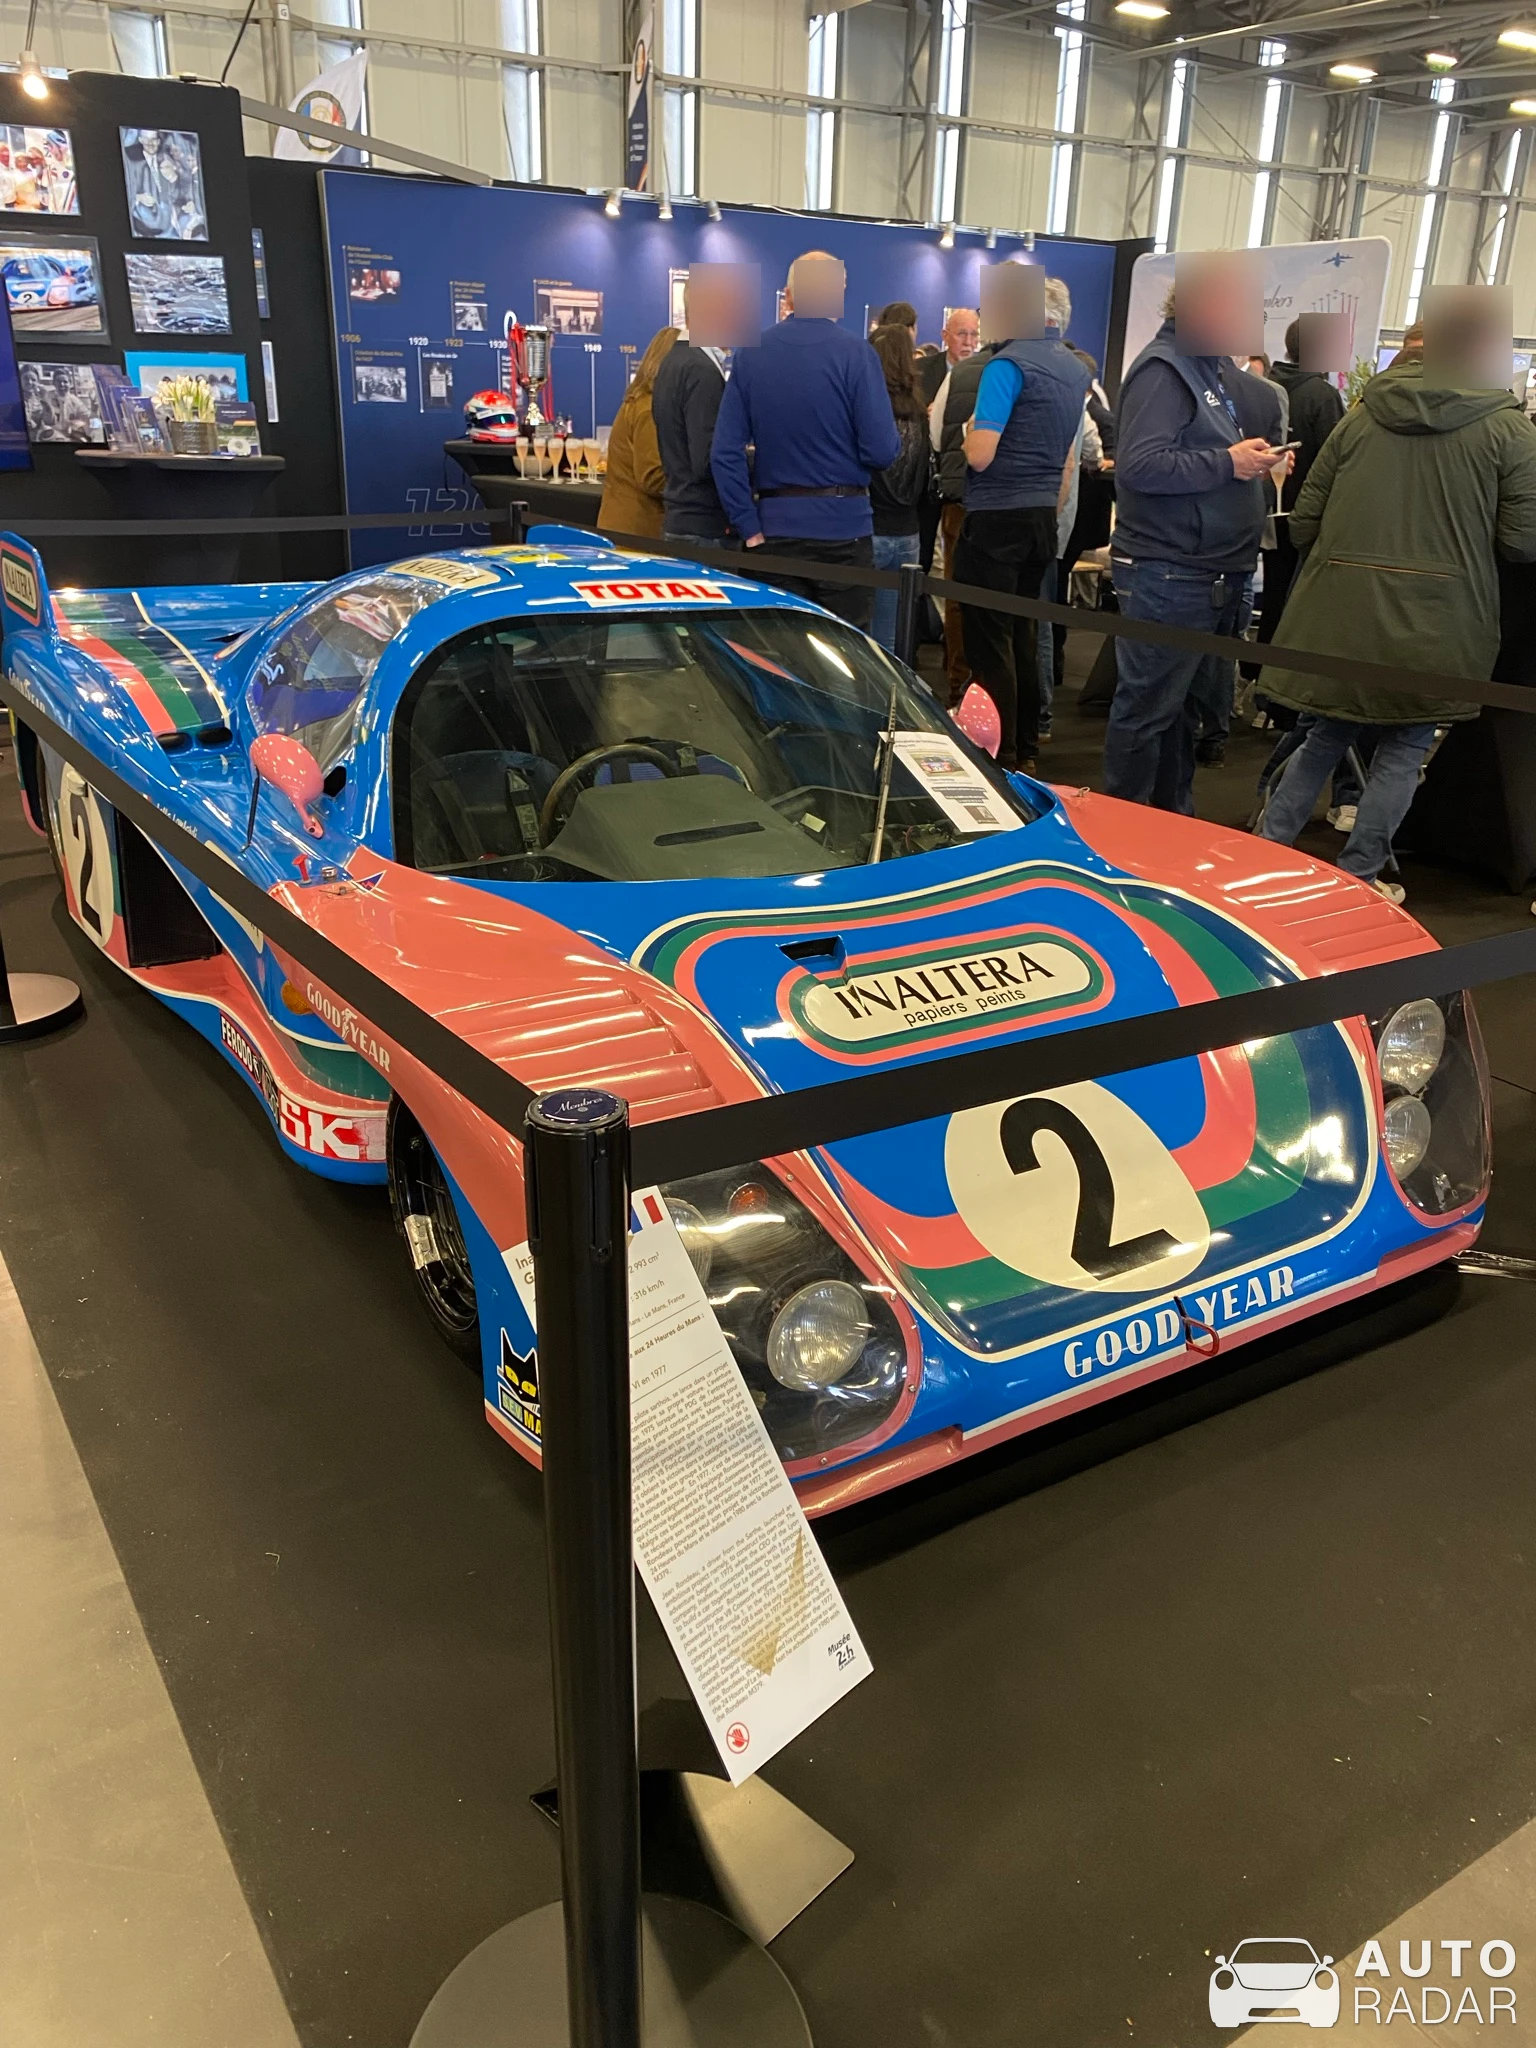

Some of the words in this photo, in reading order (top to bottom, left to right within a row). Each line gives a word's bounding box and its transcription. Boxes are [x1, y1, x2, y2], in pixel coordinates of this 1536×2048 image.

[340, 334, 361, 343] 1906
[408, 337, 429, 346] 1920
[444, 339, 464, 347] 1923
[488, 340, 507, 349] 1930
[583, 344, 602, 352] 1949
[619, 345, 636, 353] 1954
[4, 563, 34, 603] INALTERA
[579, 582, 724, 600] TOTAL
[70, 793, 102, 937] 2
[834, 951, 1055, 1019] INALTERA
[903, 1000, 968, 1027] papiers
[976, 988, 1027, 1011] peints
[221, 1016, 253, 1072] FERODO
[555, 1098, 603, 1115] Membres
[1000, 1097, 1184, 1281] 2
[634, 1289, 647, 1300] 316
[647, 1280, 664, 1292] km/h
[651, 1304, 668, 1314] Mans,
[668, 1294, 685, 1305] France
[634, 1346, 645, 1356] aux
[645, 1340, 654, 1349] 24
[654, 1329, 676, 1343] Heures
[676, 1324, 685, 1332] du
[685, 1315, 701, 1326] Mans
[632, 1380, 641, 1389] Vi
[641, 1377, 650, 1385] en
[651, 1365, 666, 1378] 1977
[634, 1409, 649, 1422] pilote
[650, 1397, 671, 1411] sarthois,
[679, 1383, 693, 1394] lance
[694, 1376, 706, 1385] dans
[714, 1362, 728, 1374] projet
[828, 1634, 850, 1656] Musée
